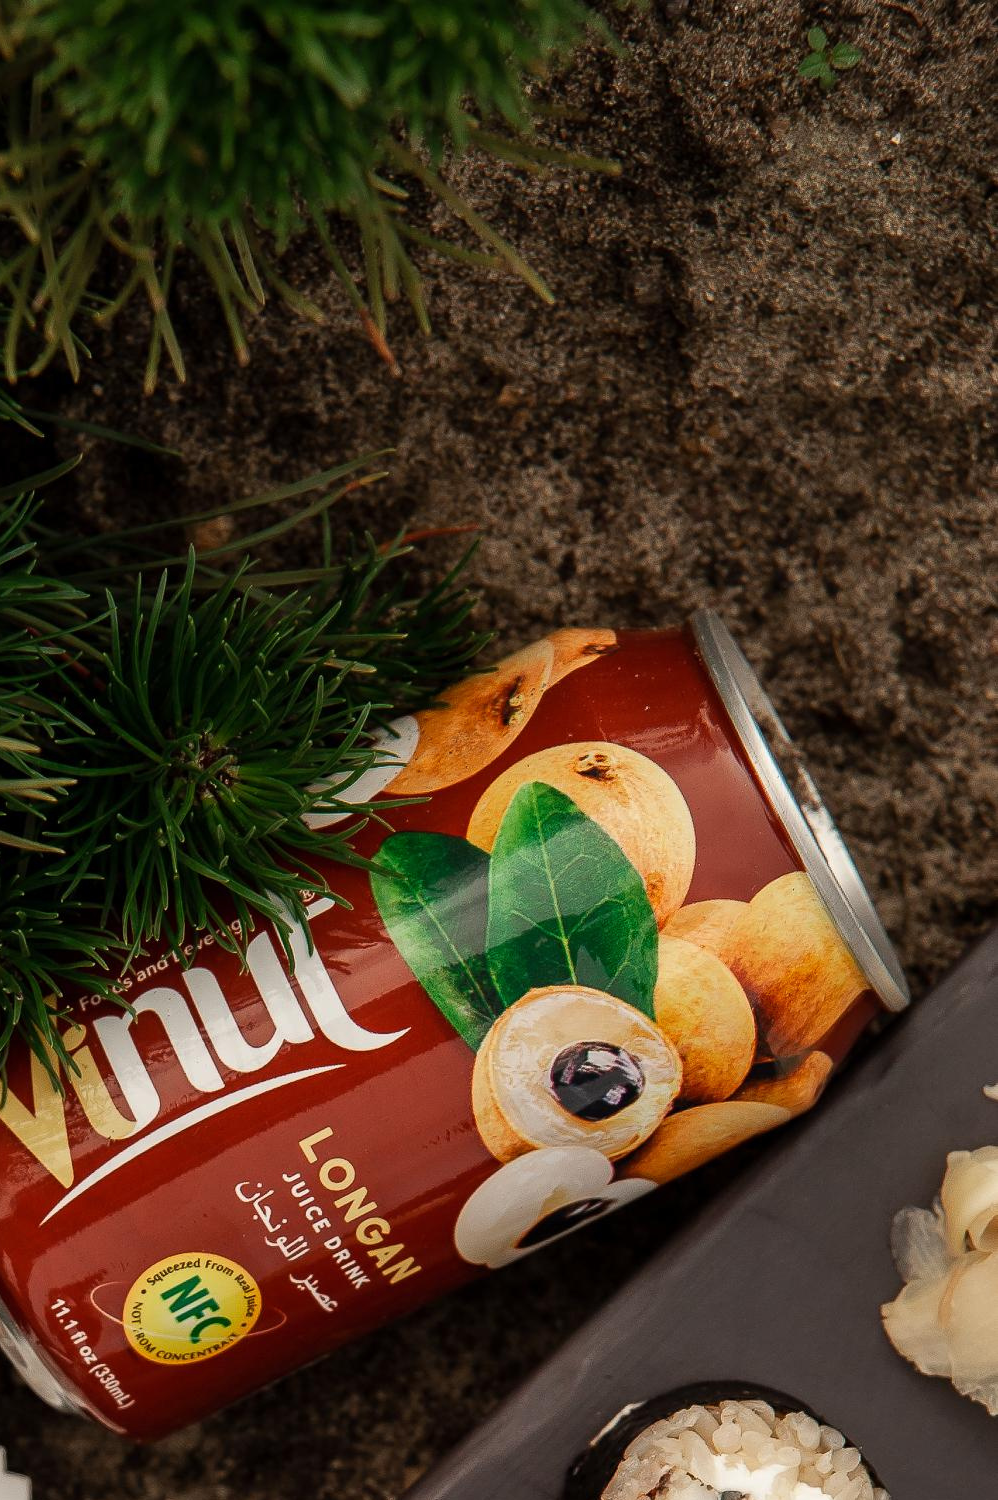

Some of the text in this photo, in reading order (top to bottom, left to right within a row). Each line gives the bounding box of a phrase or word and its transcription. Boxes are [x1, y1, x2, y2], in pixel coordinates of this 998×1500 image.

[79, 969, 133, 1012] Fods
[282, 1172, 371, 1290] JUICE DRINK
[298, 1126, 422, 1285] LONGAN
[146, 1258, 201, 1287] Squeezed
[204, 1259, 234, 1277] From
[234, 1274, 255, 1293] Real
[289, 1273, 339, 1312] عصير
[50, 1298, 79, 1330] 11.1
[70, 1331, 88, 1345] fl
[79, 1345, 98, 1365] oz
[131, 1301, 144, 1325] NOT
[160, 1274, 232, 1345] NFC
